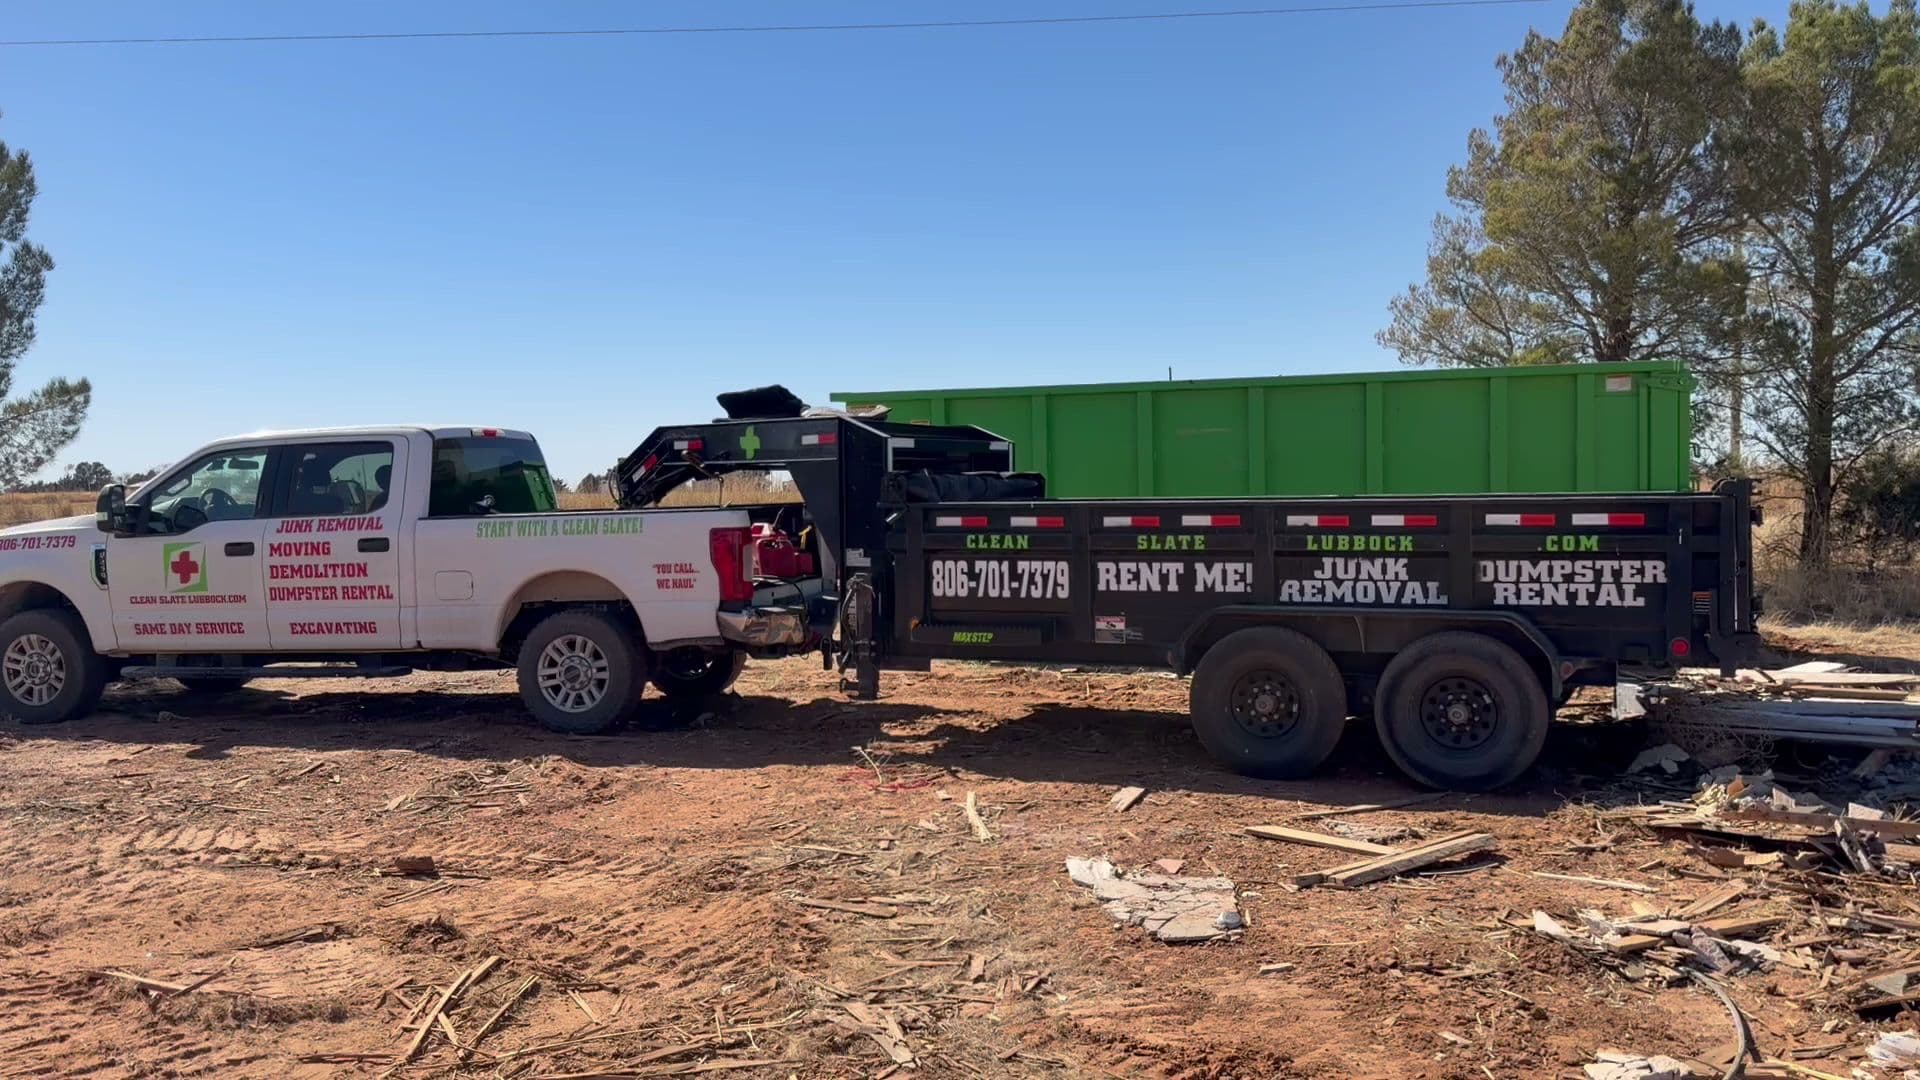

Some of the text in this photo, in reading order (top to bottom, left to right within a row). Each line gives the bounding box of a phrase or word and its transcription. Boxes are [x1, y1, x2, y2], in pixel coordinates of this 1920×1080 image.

[276, 517, 384, 534] JUNK REMOVAL
[476, 517, 644, 538] START WITH A CLEAN SLATE!
[269, 541, 332, 557] MOVING
[966, 534, 1029, 550] CLEAN
[1137, 534, 1206, 550] SLATE
[1306, 534, 1414, 552] LUBBOCK
[269, 562, 369, 579] DEMOLITION
[1097, 561, 1254, 593] RENT ME!
[1313, 556, 1409, 581] JUNK
[1479, 559, 1668, 584] DUMPSTER
[656, 578, 671, 589] WE
[931, 559, 1070, 599] 806-701-7379
[129, 594, 247, 605] CLEAN SLATE LUBBOCK.COM
[269, 585, 394, 602] DUMPSTER RENTAL
[1279, 579, 1449, 605] REMOVAL
[1493, 583, 1646, 607] RENTAL
[134, 622, 245, 635] SAME DAY SERVICE
[289, 621, 378, 635] EXCAVATING
[952, 631, 994, 643] MAXSTEP
